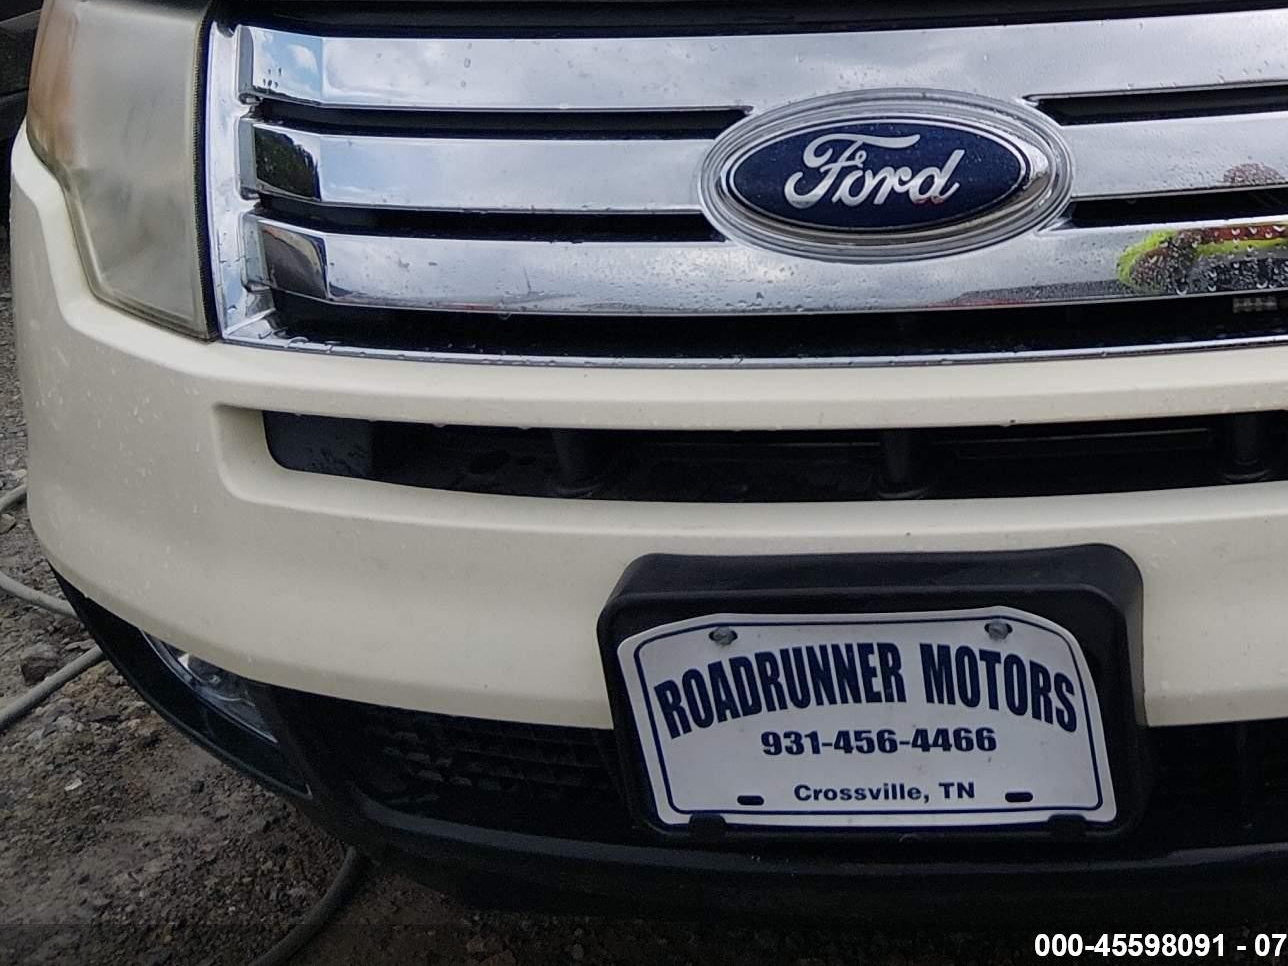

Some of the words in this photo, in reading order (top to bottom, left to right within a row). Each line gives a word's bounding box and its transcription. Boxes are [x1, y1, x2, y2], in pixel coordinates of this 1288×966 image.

[784, 133, 966, 209] Ford
[654, 642, 907, 739] ROADRUNNER
[919, 643, 1078, 733] MOTORS
[761, 727, 997, 756] 931-456-4466
[793, 784, 930, 803] Crossville,
[938, 782, 976, 801] TN
